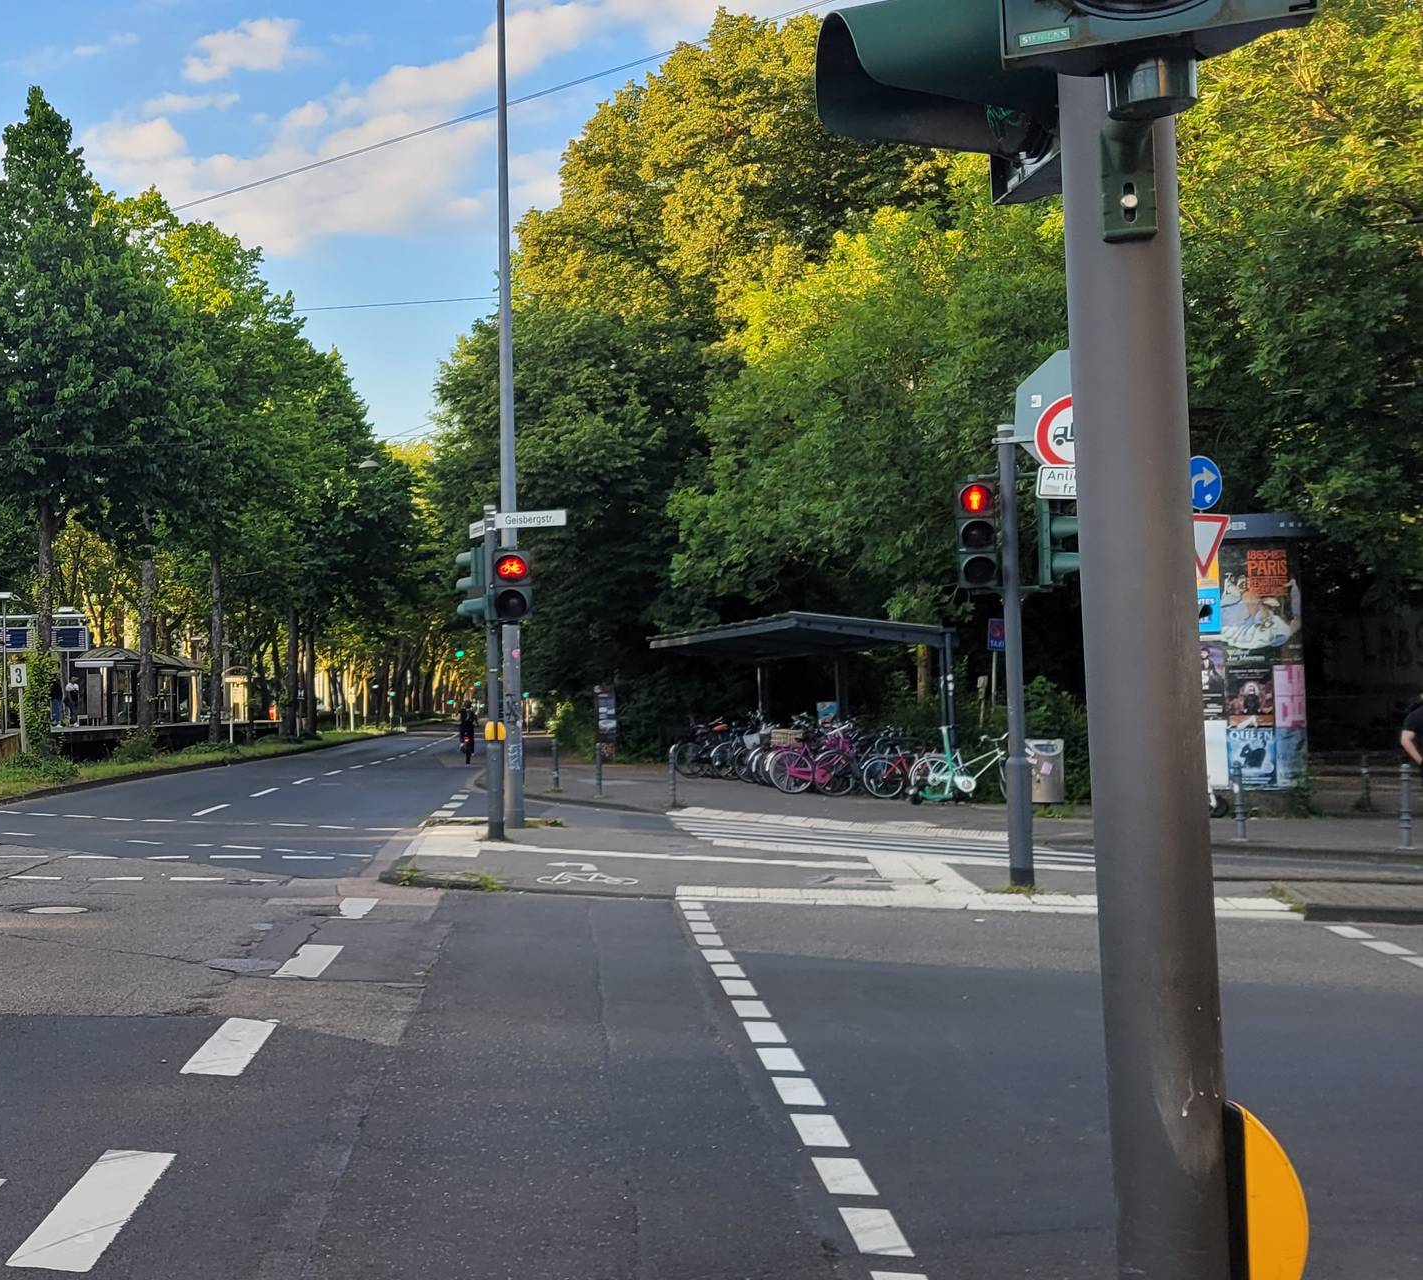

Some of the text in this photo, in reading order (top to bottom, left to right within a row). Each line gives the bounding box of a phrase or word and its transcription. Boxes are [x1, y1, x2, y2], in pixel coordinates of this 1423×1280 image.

[1047, 469, 1076, 481] Anli
[1063, 483, 1077, 494] fr
[505, 514, 555, 526] Geisbergstr.
[1247, 560, 1287, 576] PARIS
[15, 667, 23, 684] 3
